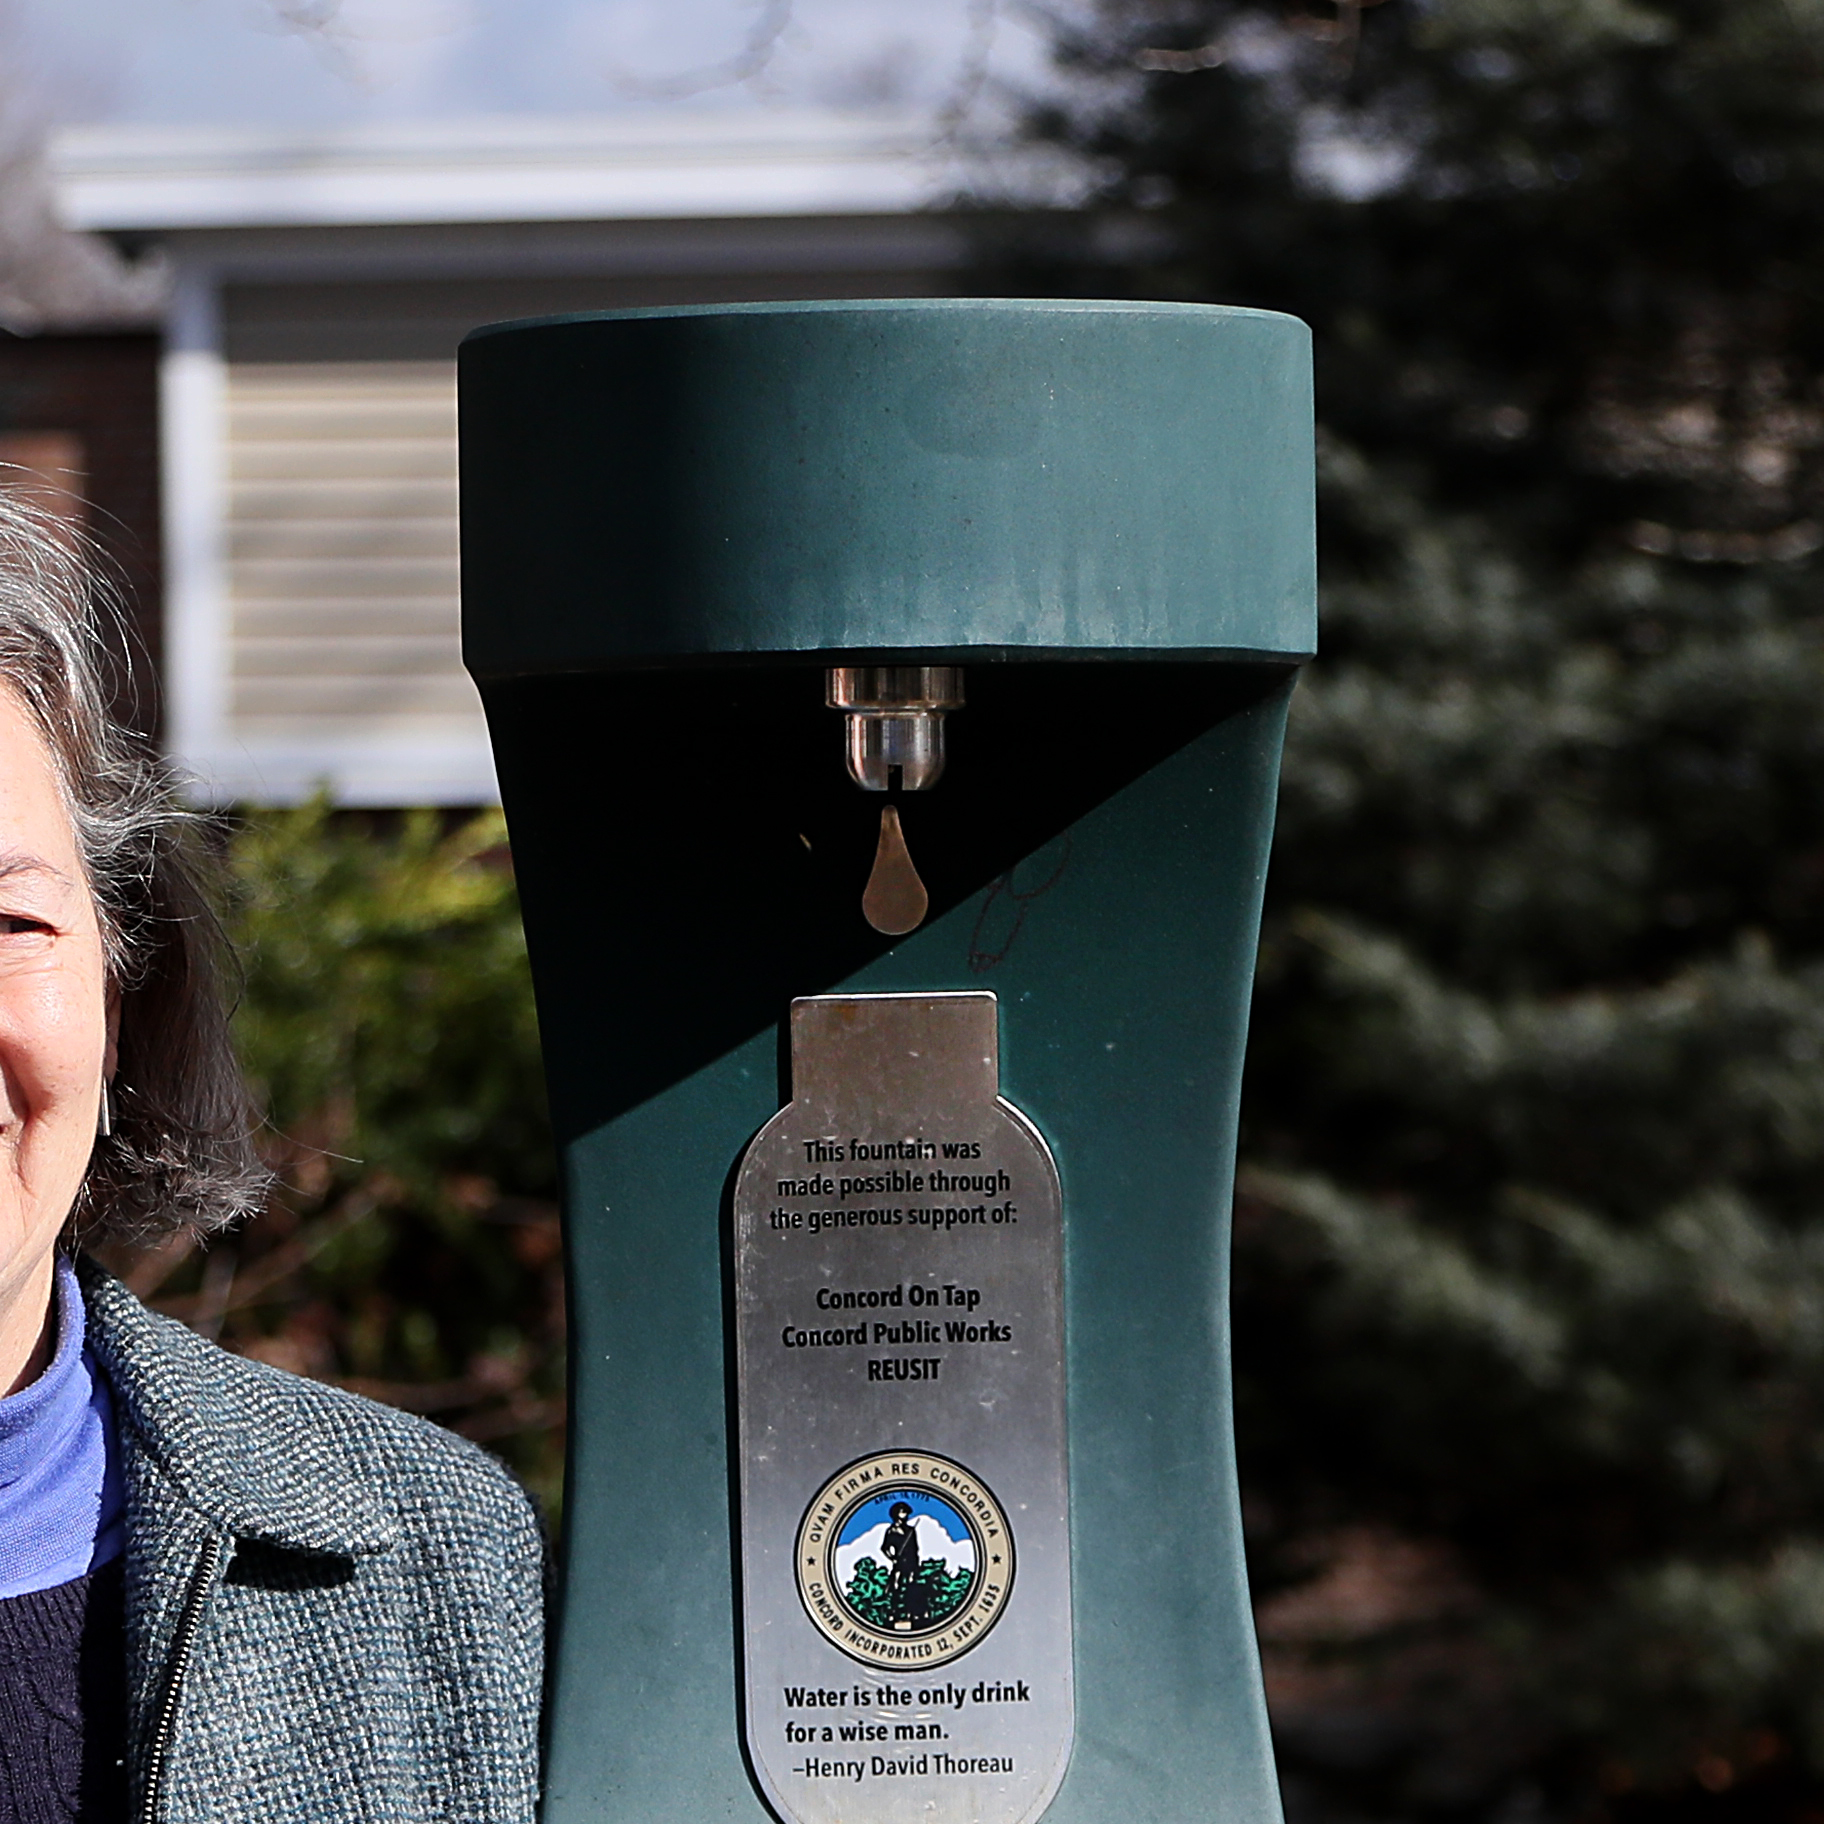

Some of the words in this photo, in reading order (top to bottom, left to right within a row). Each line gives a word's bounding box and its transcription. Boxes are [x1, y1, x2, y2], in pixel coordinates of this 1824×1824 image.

[804, 1140, 844, 1162] This
[850, 1139, 937, 1161] fountain
[941, 1143, 981, 1158] was
[777, 1173, 834, 1196] made
[840, 1171, 924, 1200] possible
[929, 1170, 1010, 1197] through
[770, 1209, 803, 1229] the
[809, 1210, 903, 1233] generous
[908, 1205, 986, 1231] support
[991, 1202, 1017, 1224] of:
[816, 1285, 902, 1309] Concord
[909, 1285, 939, 1306] On
[944, 1285, 980, 1311] Tap
[782, 1323, 868, 1347] Concord
[874, 1321, 940, 1344] Public
[945, 1320, 1012, 1342] Works
[868, 1358, 940, 1381] REUSIT
[810, 1504, 835, 1543] QVAM
[836, 1467, 883, 1500] FIRMA
[892, 1463, 920, 1475] RES
[930, 1467, 1000, 1538] CONCORDIA
[809, 1583, 844, 1631] CONCORD
[844, 1629, 932, 1660] INCORPORATED
[954, 1618, 983, 1642] SEPT.
[978, 1584, 1000, 1613] 1635
[784, 1687, 848, 1707] Water
[853, 1686, 871, 1706] is
[876, 1685, 913, 1706] the
[919, 1684, 966, 1709] only
[972, 1680, 1030, 1703] drink
[785, 1722, 816, 1743] for
[821, 1727, 833, 1741] a
[838, 1721, 888, 1741] wise
[894, 1723, 949, 1739] man.
[871, 1755, 928, 1776] David
[933, 1754, 1013, 1775] Thoreau
